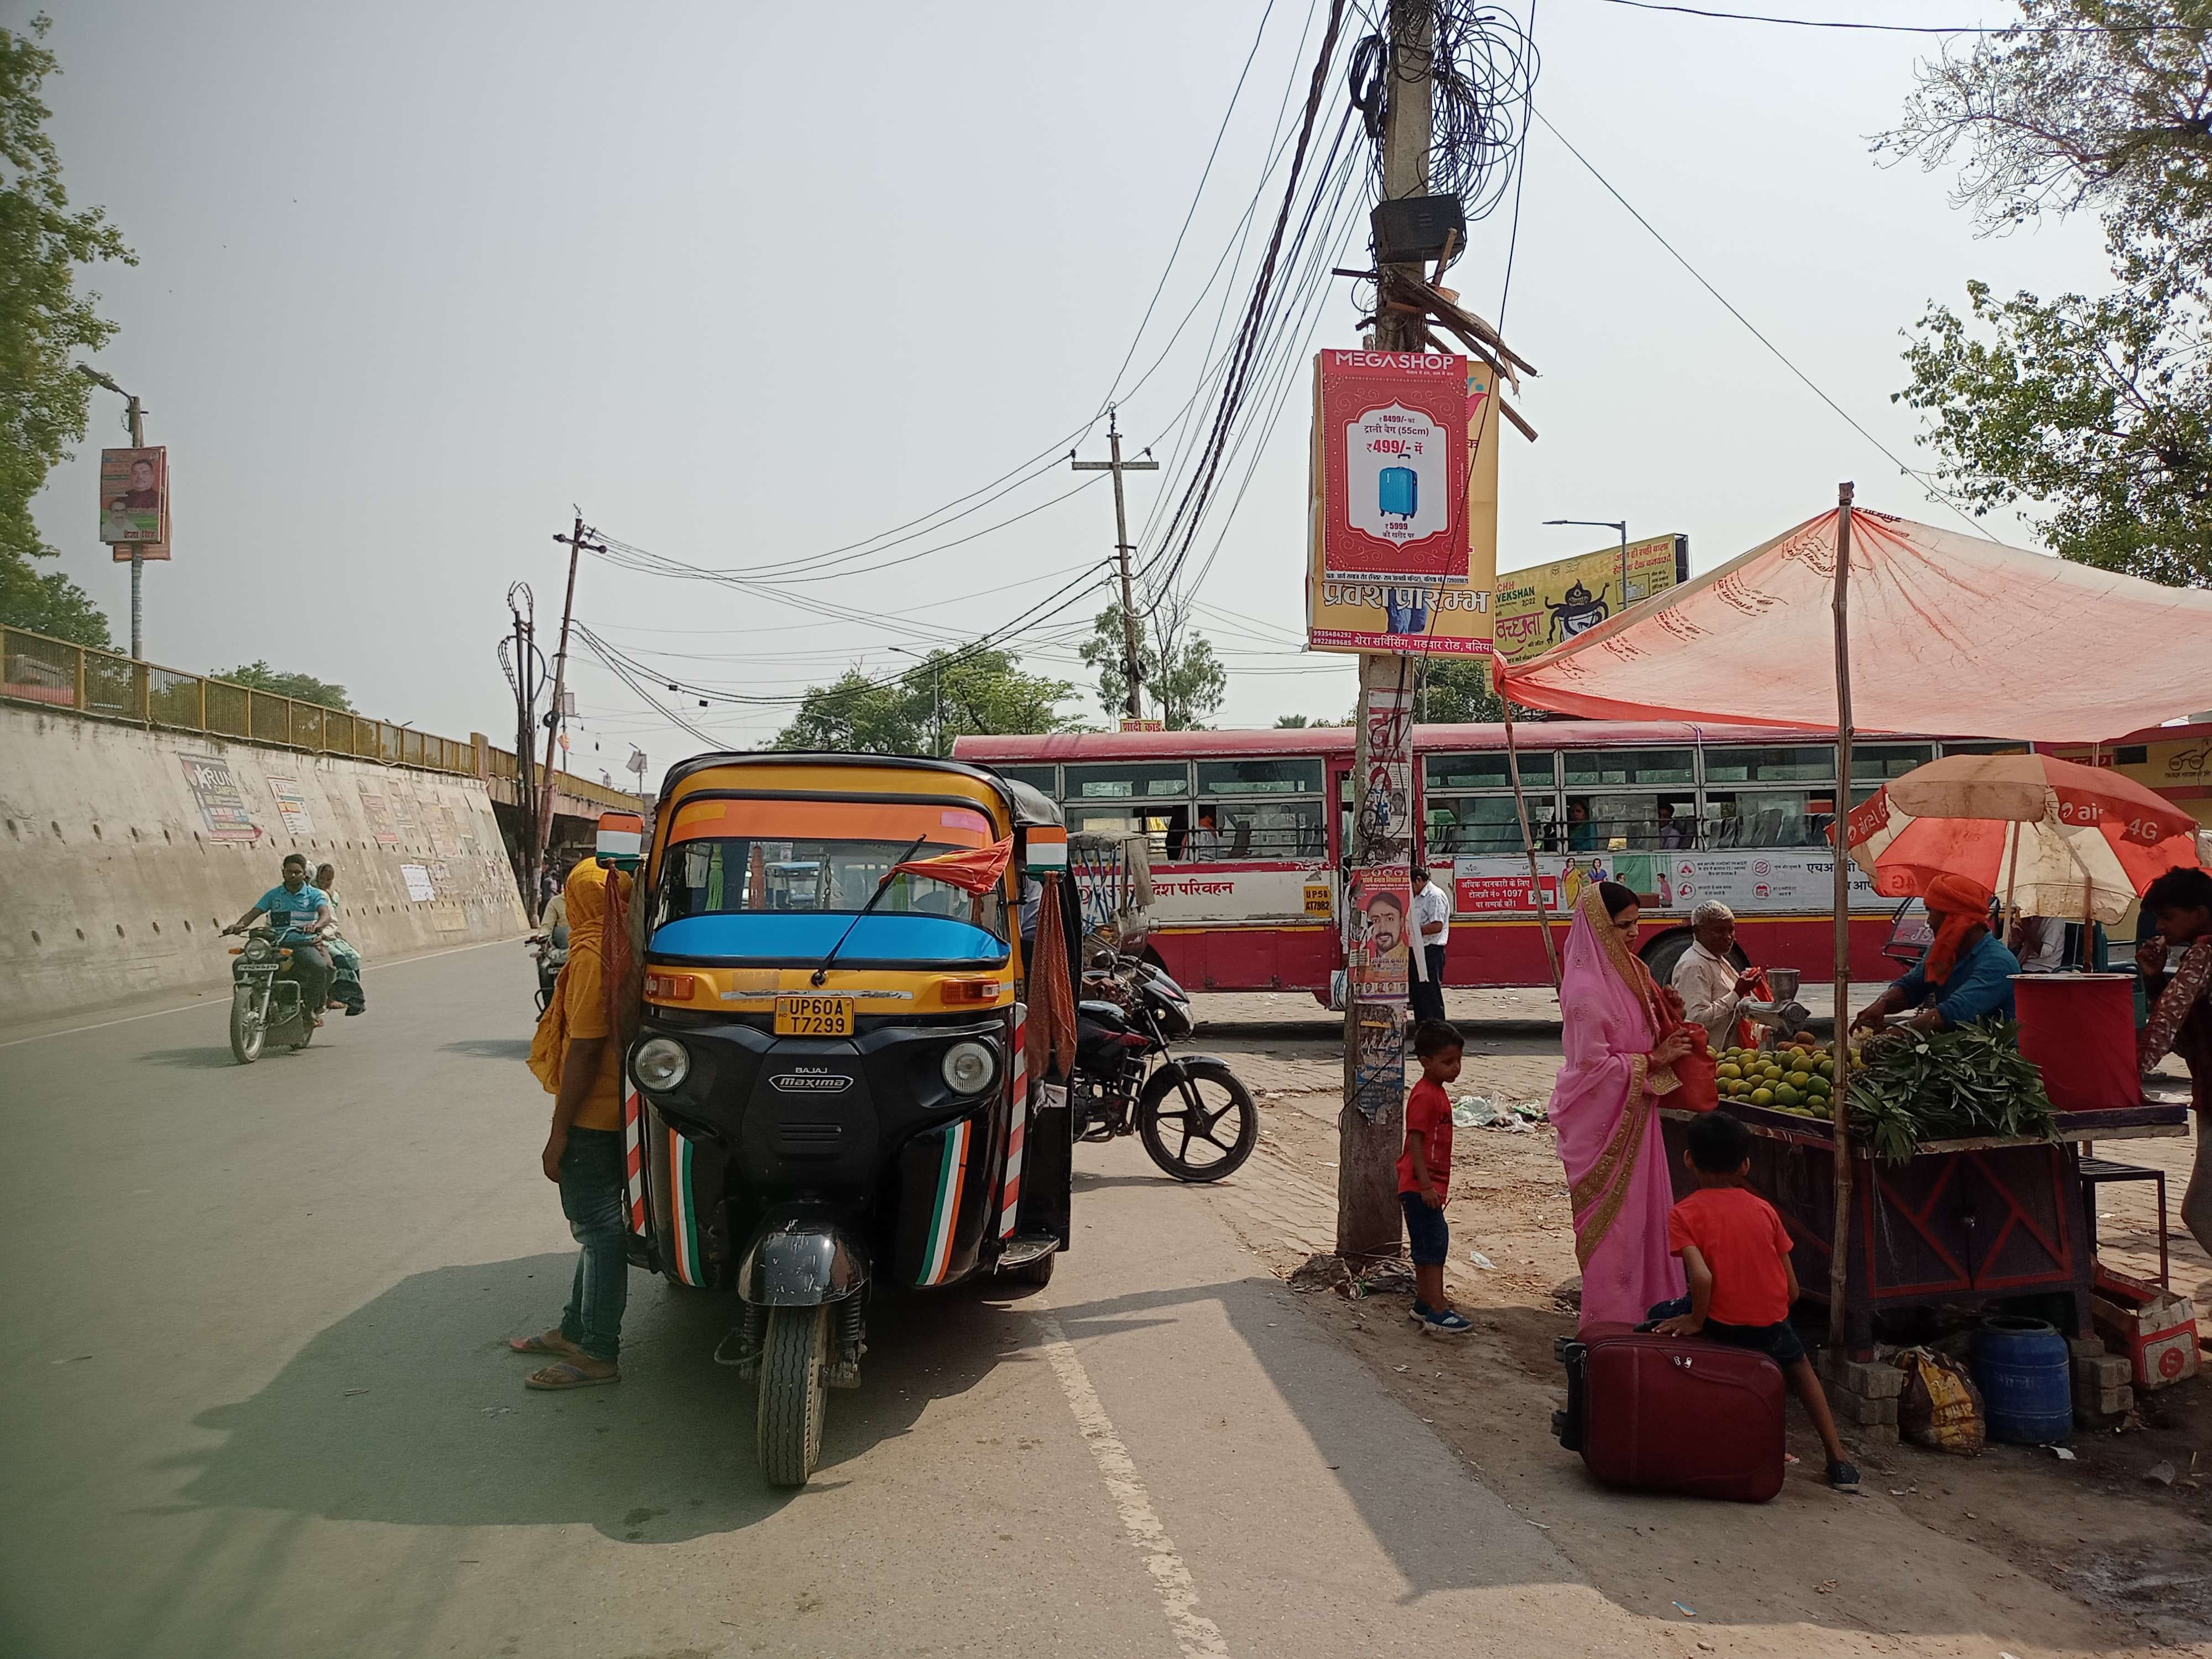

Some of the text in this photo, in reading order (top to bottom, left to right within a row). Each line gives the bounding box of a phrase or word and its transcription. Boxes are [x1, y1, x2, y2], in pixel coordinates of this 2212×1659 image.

[1335, 351, 1454, 370] MEGASHOP
[1398, 426, 1429, 437] (55cm)
[1414, 442, 1423, 455] में
[1653, 542, 1668, 552] वाला
[1496, 581, 1514, 593] CHH
[1394, 586, 1491, 613] प्रारम्भ
[1495, 586, 1535, 603] VEKSHAN
[1522, 598, 1535, 607] 2022
[1496, 611, 1544, 643] वच्छता
[1123, 721, 1141, 732] शादी
[2129, 818, 2158, 841] 4G
[1177, 878, 1234, 896] परिवहन
[1482, 879, 1507, 888] जानकारी
[1509, 879, 1516, 888] के
[1517, 878, 1530, 888] लिए
[1502, 889, 1522, 898] 1097
[790, 999, 843, 1015] UP60A
[791, 1016, 845, 1033] T7299
